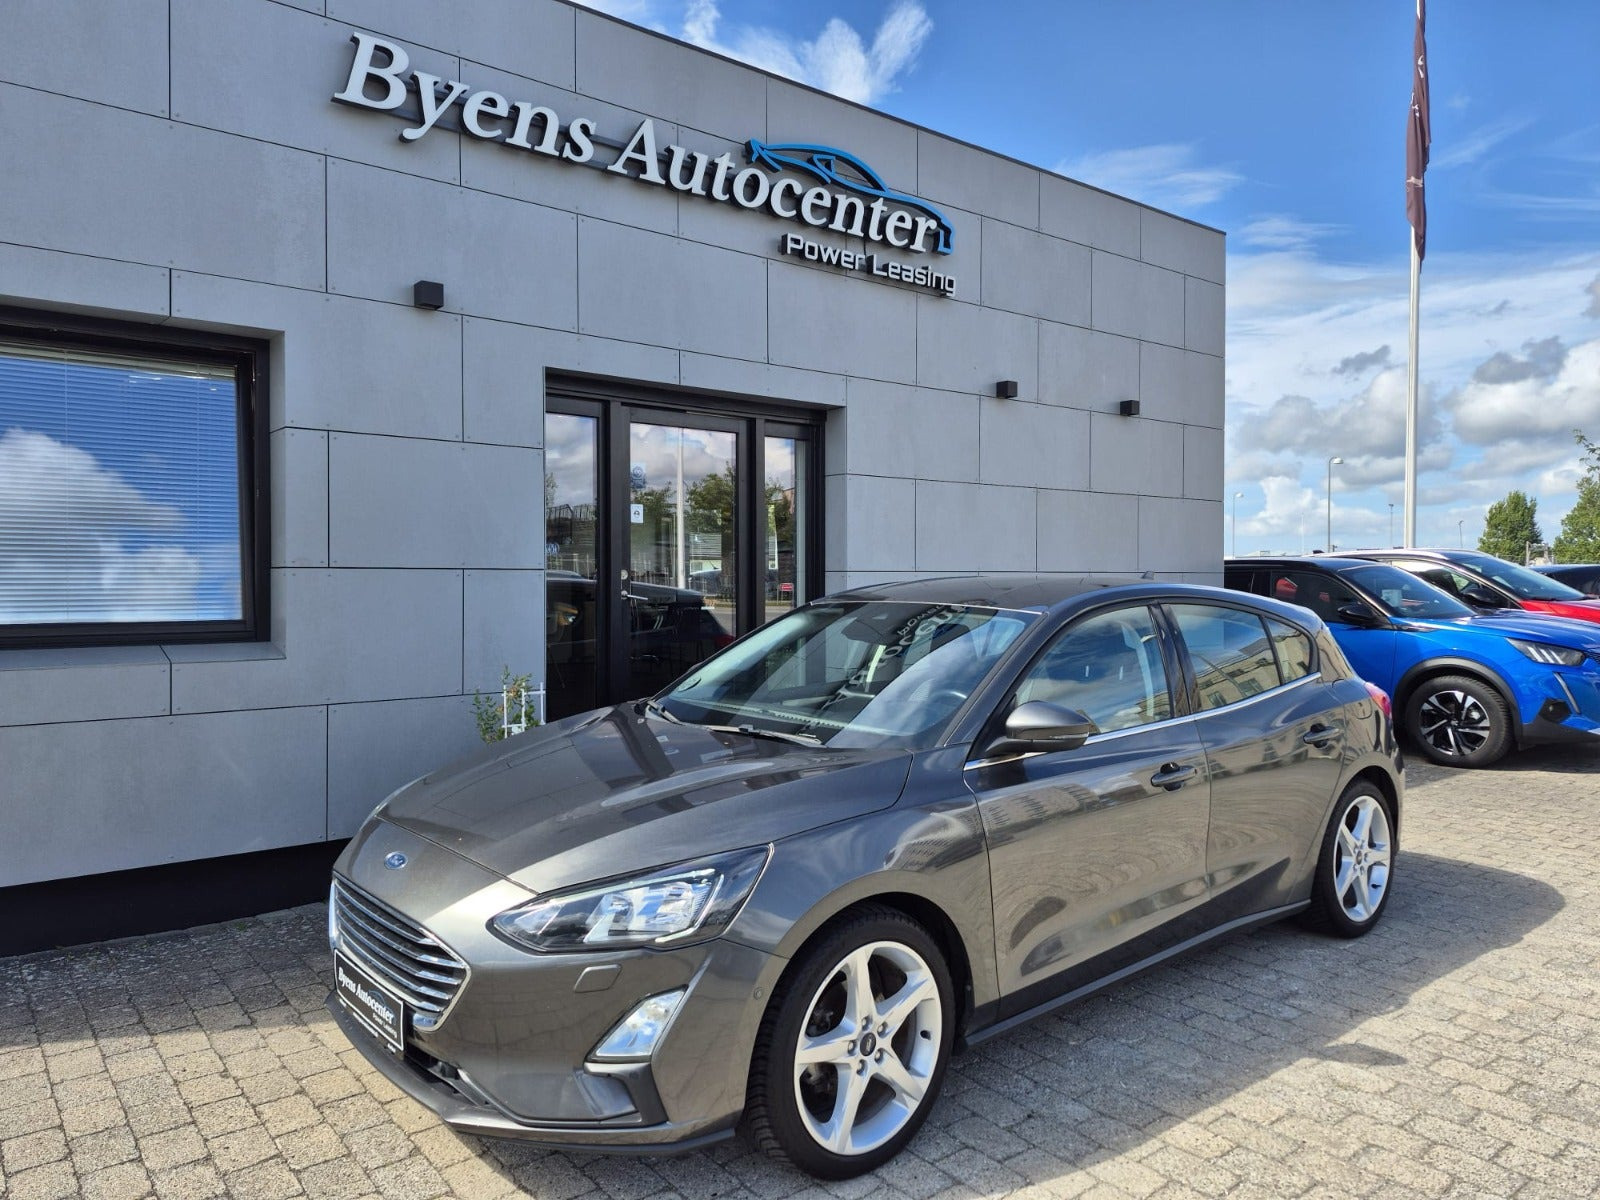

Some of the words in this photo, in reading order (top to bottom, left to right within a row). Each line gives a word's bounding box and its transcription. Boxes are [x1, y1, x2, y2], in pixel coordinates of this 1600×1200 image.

[332, 31, 598, 163] Byens
[606, 118, 938, 252] Autocenter
[784, 232, 866, 271] Power
[871, 254, 957, 296] Leasing
[337, 966, 357, 994] Byens
[355, 983, 395, 1024] Autocenter
